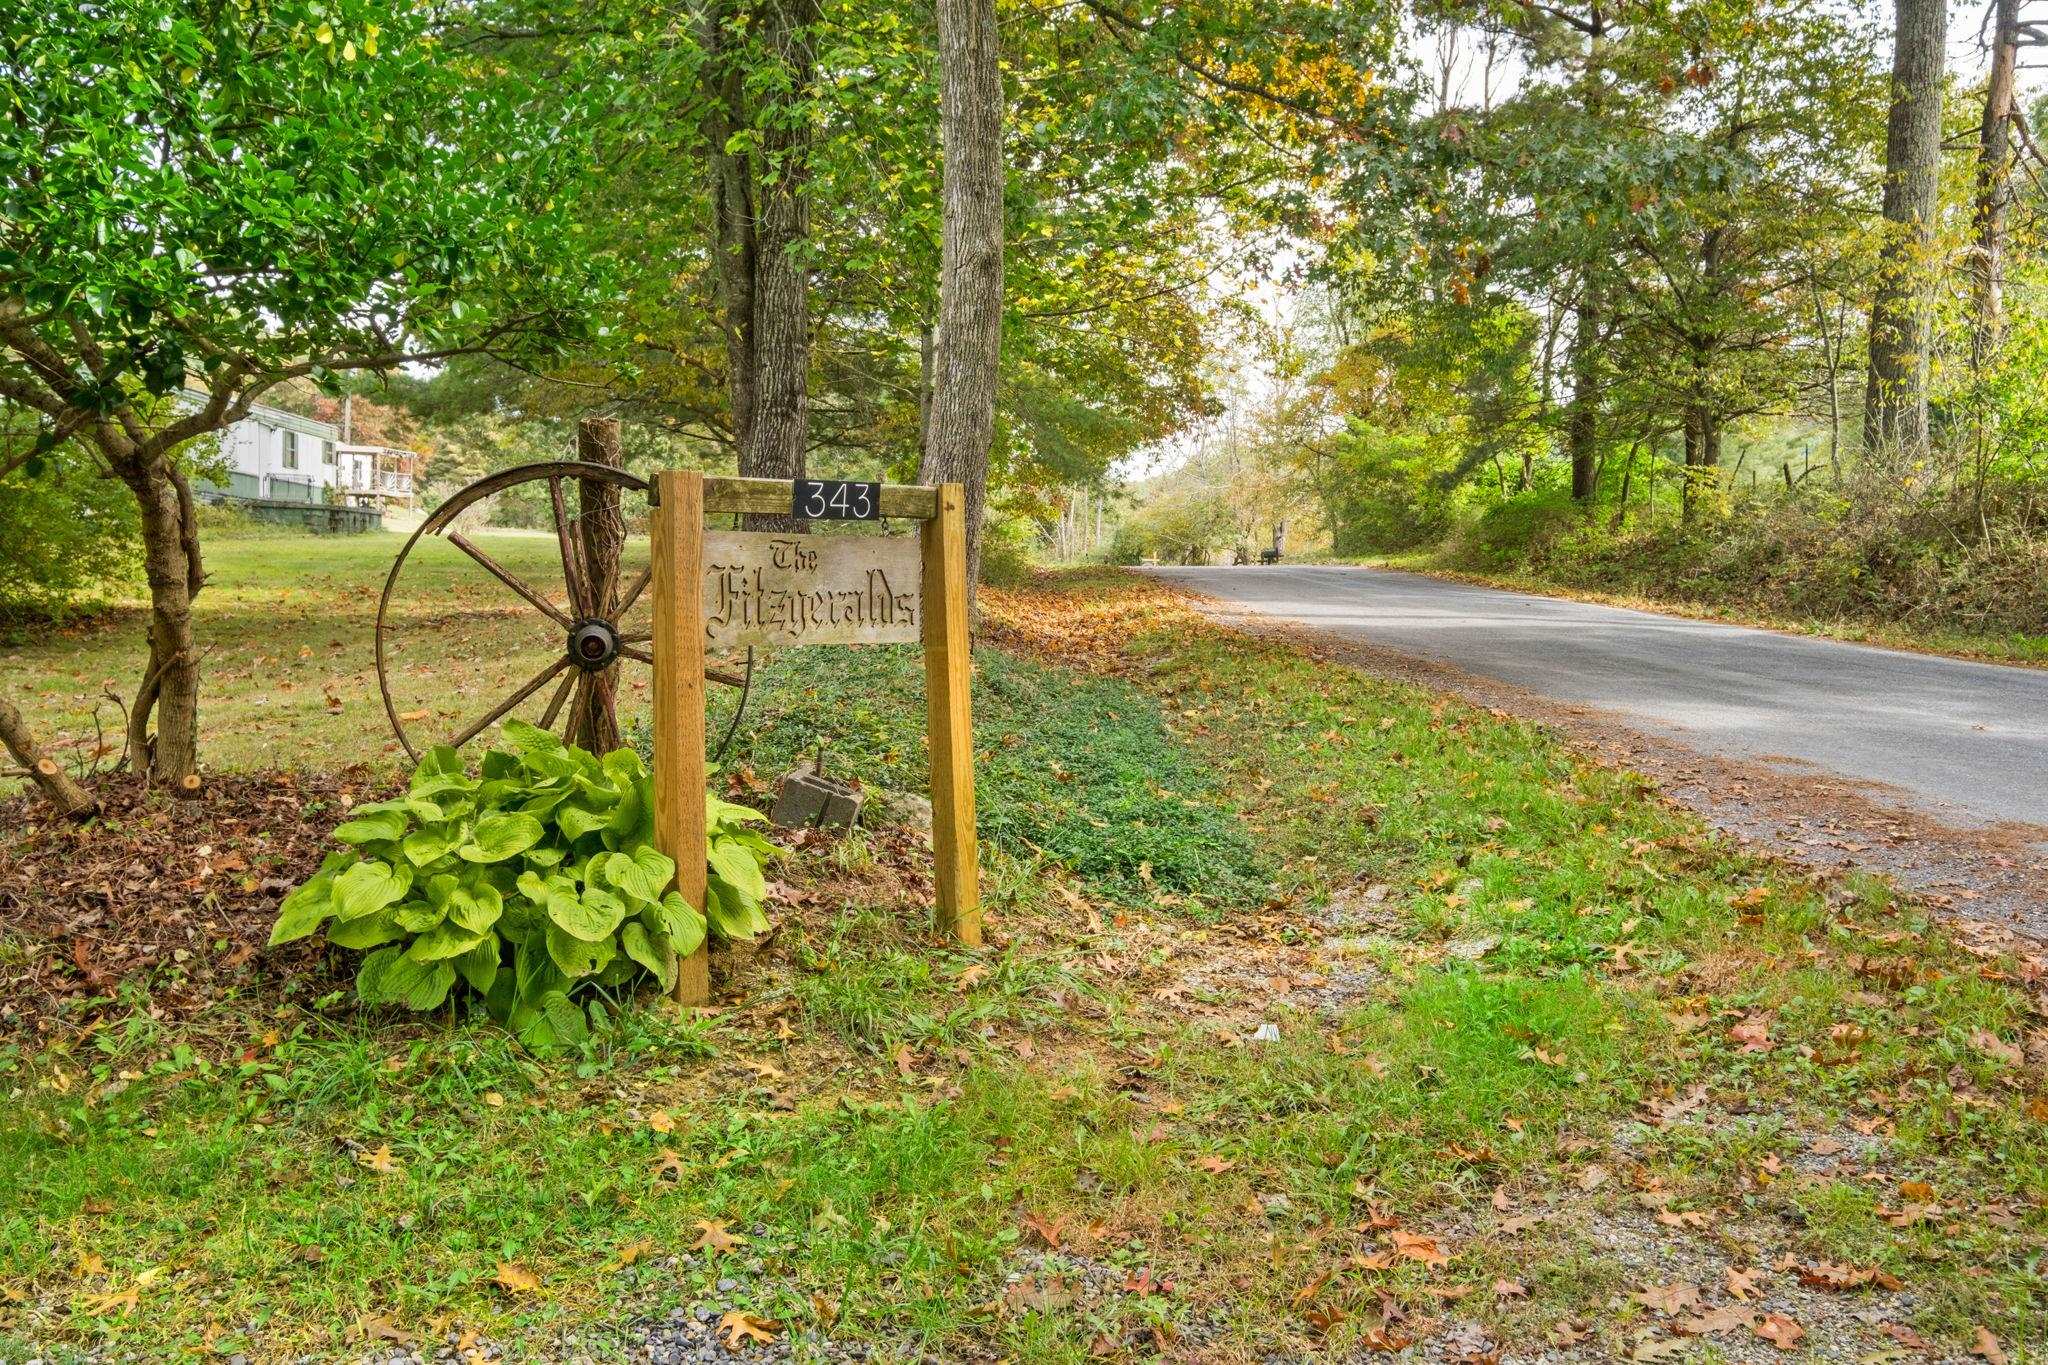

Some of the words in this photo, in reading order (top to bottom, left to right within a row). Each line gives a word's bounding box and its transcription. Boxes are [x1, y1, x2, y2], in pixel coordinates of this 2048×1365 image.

[804, 482, 871, 518] 343
[769, 539, 818, 573] The
[705, 564, 915, 639] Fitzgeralds
